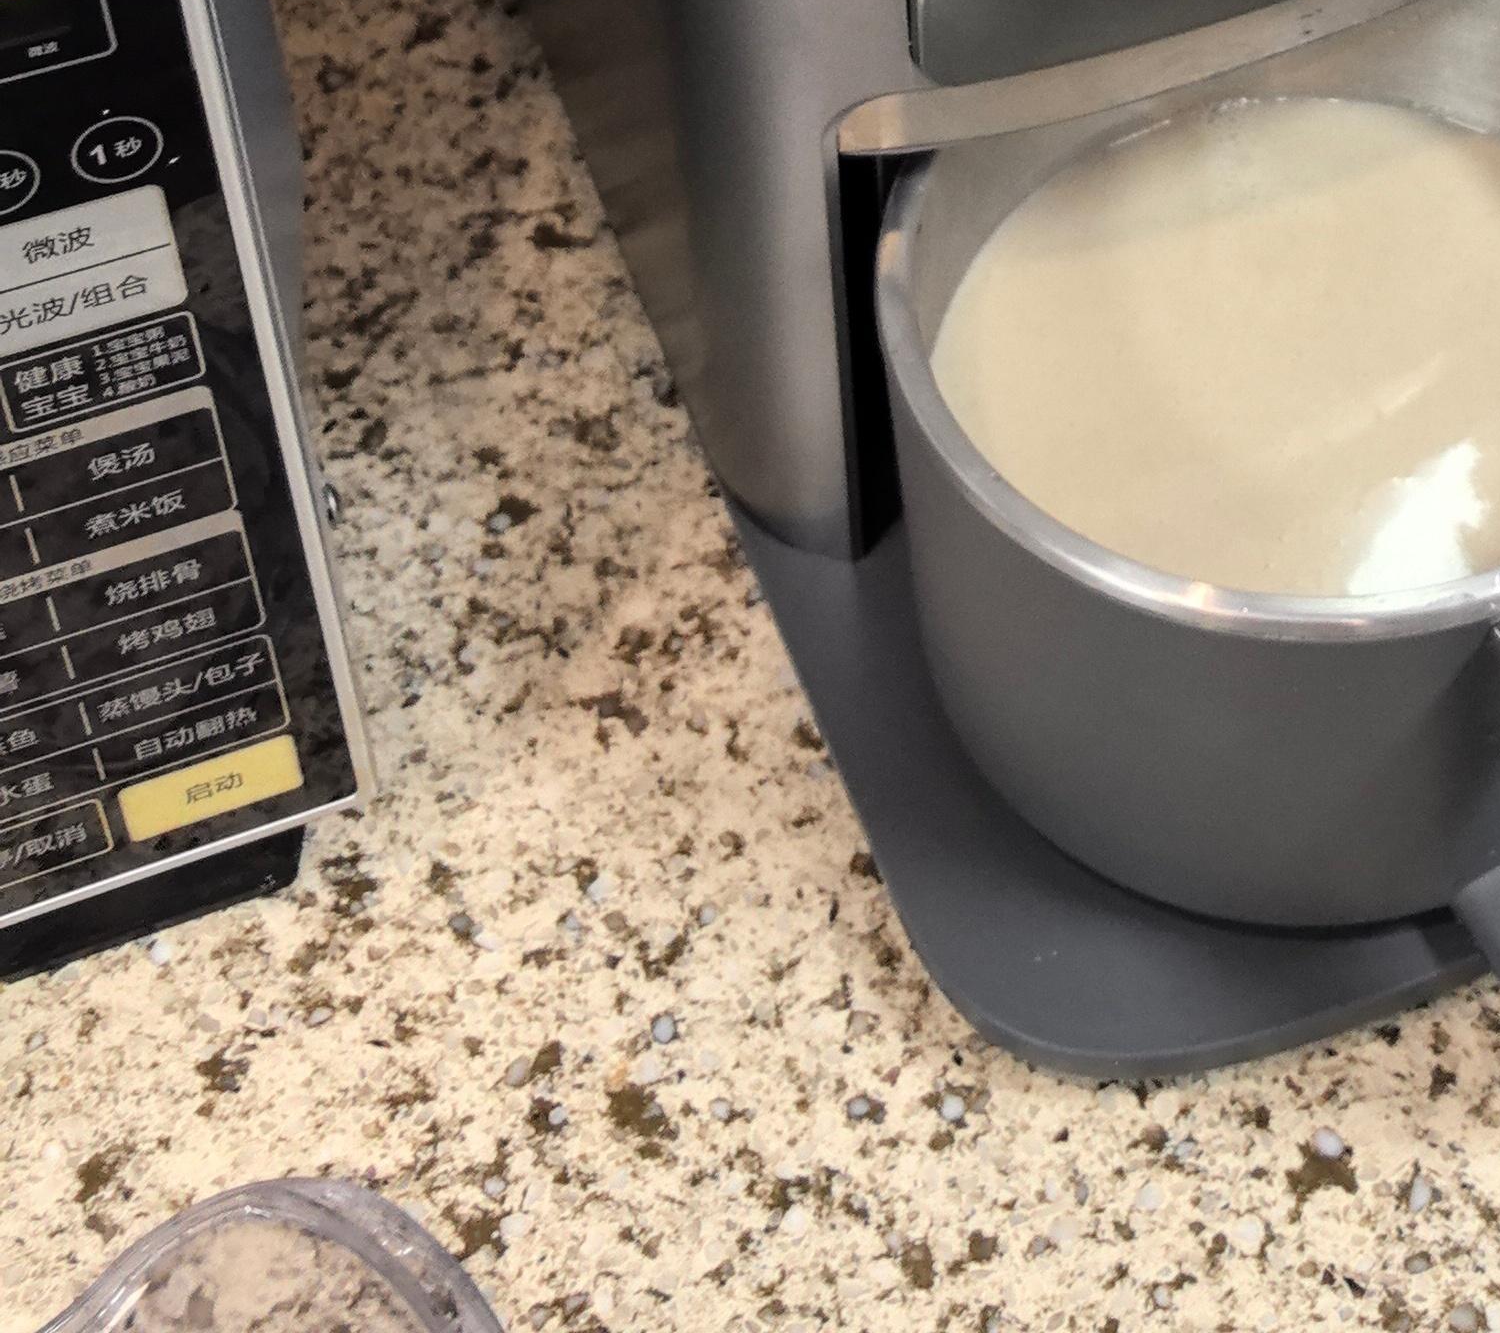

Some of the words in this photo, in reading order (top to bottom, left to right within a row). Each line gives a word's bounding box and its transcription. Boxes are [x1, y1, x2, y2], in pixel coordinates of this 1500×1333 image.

[88, 136, 143, 166] 1秒
[22, 226, 95, 265] 微波
[0, 275, 148, 334] 光波/组合
[14, 354, 85, 394] 健康
[20, 383, 94, 422] 宝宝
[87, 442, 156, 482] 煲汤
[83, 488, 187, 540] 煮米饭
[104, 558, 202, 607] 烧排骨
[116, 607, 217, 656] 烤鸡翅
[97, 652, 266, 724] 蒸馒头/包子
[185, 771, 245, 806] 启动
